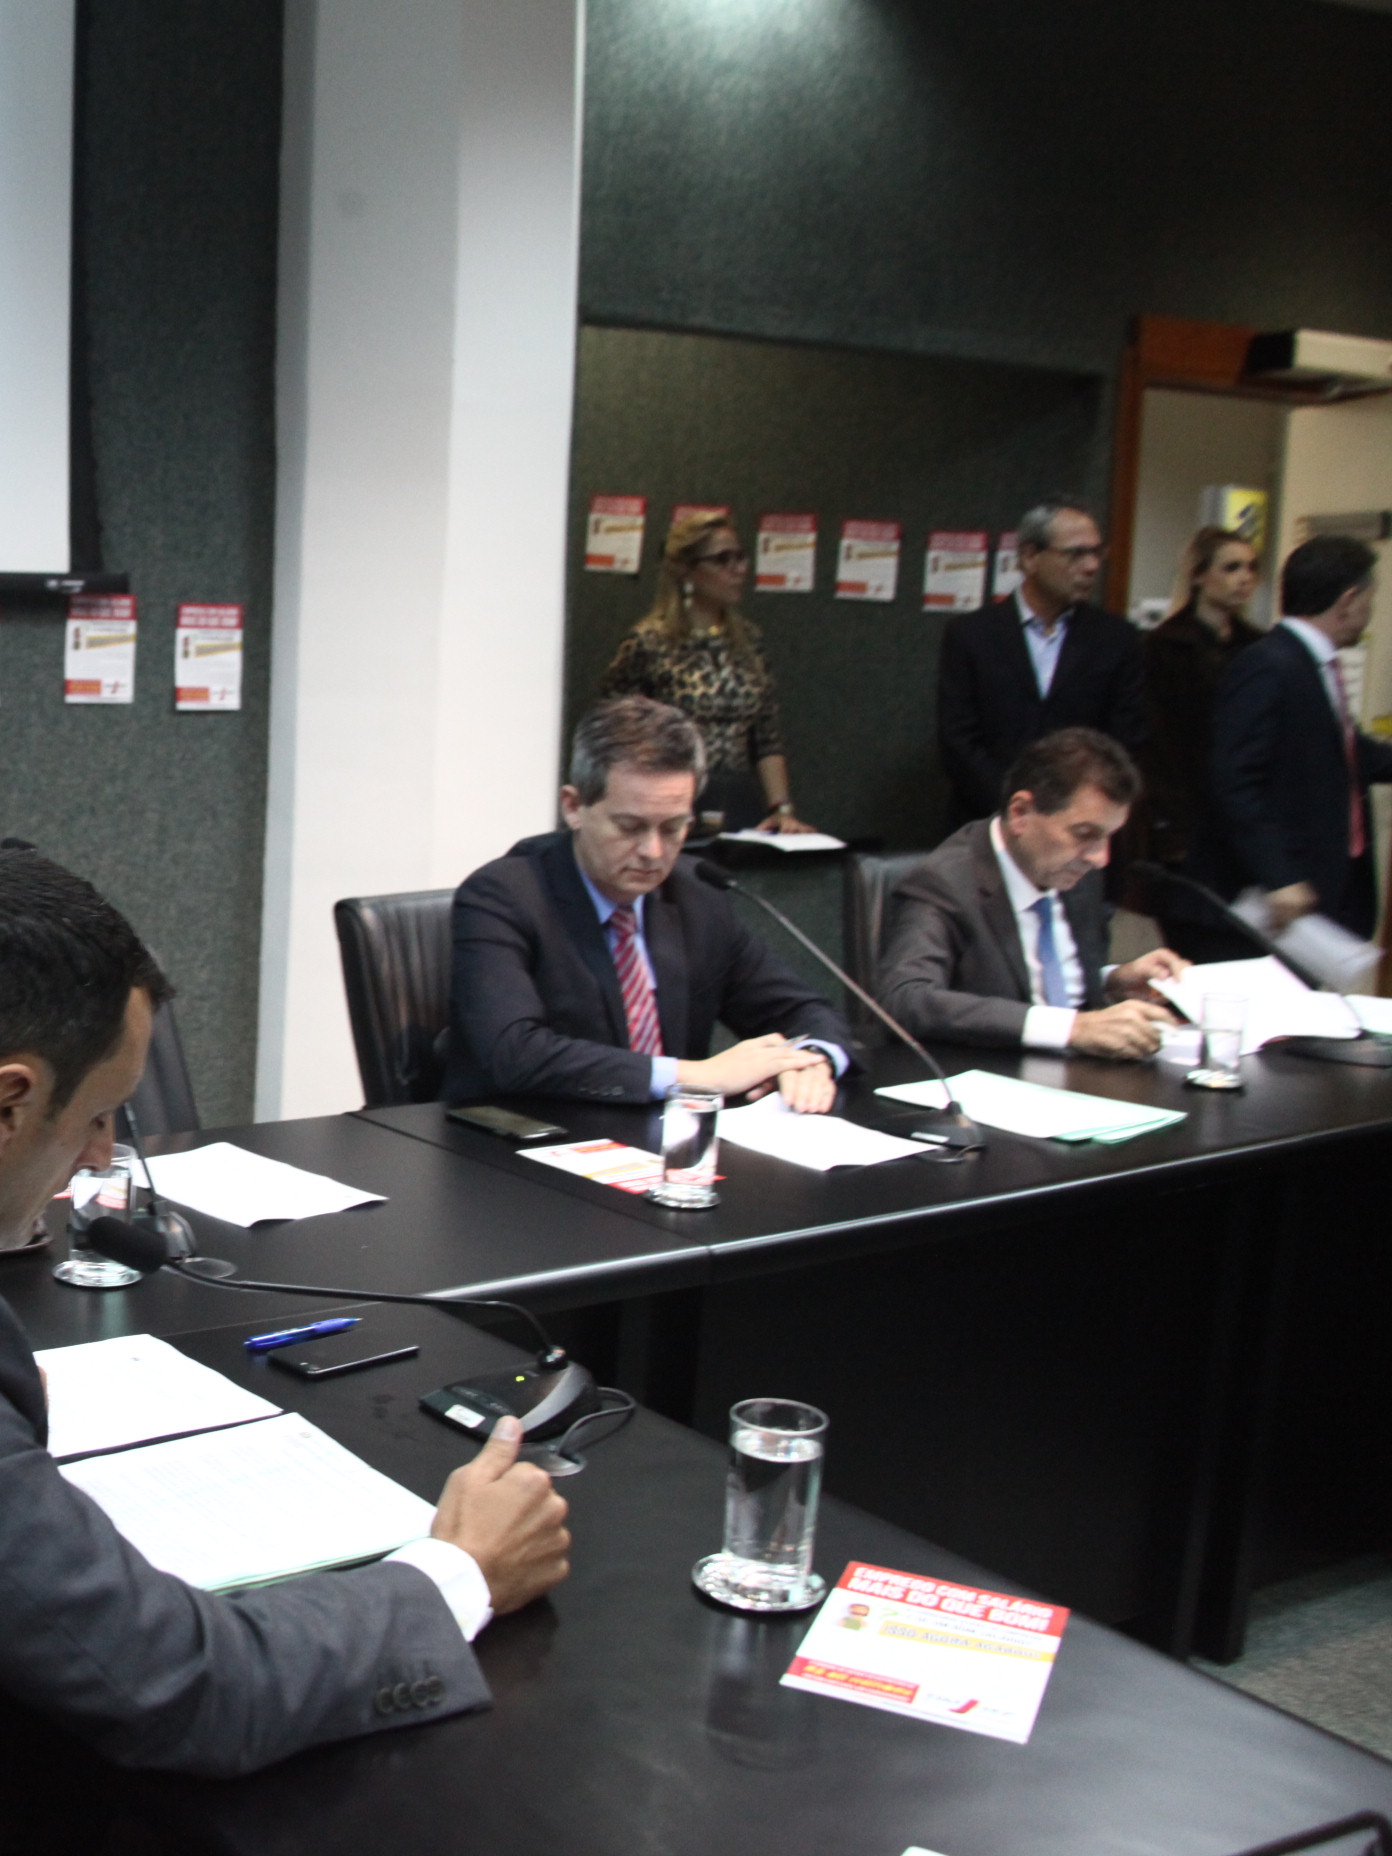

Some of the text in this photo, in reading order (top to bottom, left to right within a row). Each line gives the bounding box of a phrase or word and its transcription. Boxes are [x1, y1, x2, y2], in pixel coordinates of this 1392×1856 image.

[847, 1577, 906, 1601] MAIS
[906, 1590, 941, 1608] DO
[940, 1597, 986, 1618] QUE
[988, 1608, 1051, 1632] BOM!
[852, 1566, 1053, 1619] EMPREGO COM SALÁRIO
